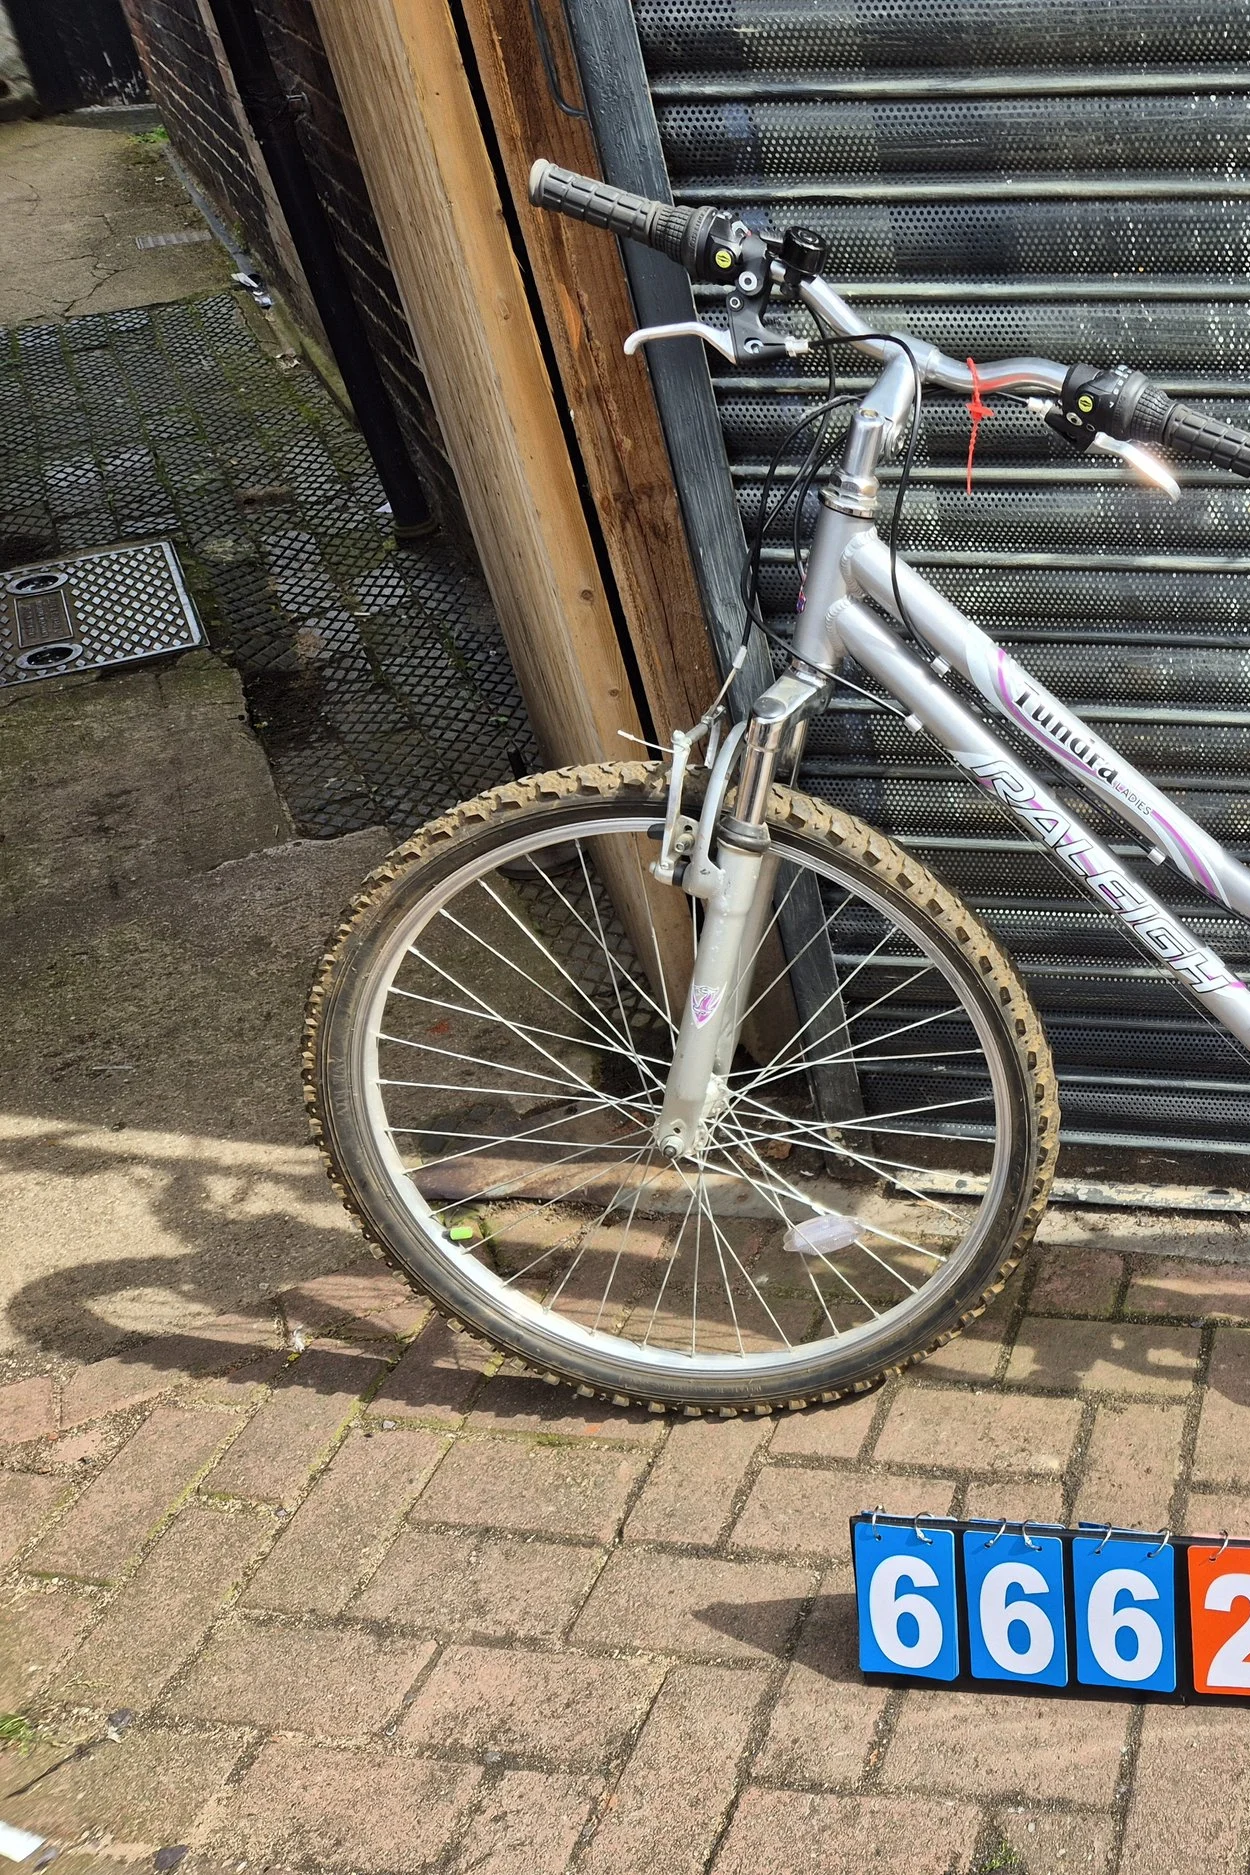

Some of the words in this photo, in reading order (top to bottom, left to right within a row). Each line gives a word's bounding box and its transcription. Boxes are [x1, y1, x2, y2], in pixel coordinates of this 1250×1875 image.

[1014, 681, 1118, 785] Tundra
[1115, 783, 1152, 815] LADIES
[970, 761, 1230, 994] RALEIGH
